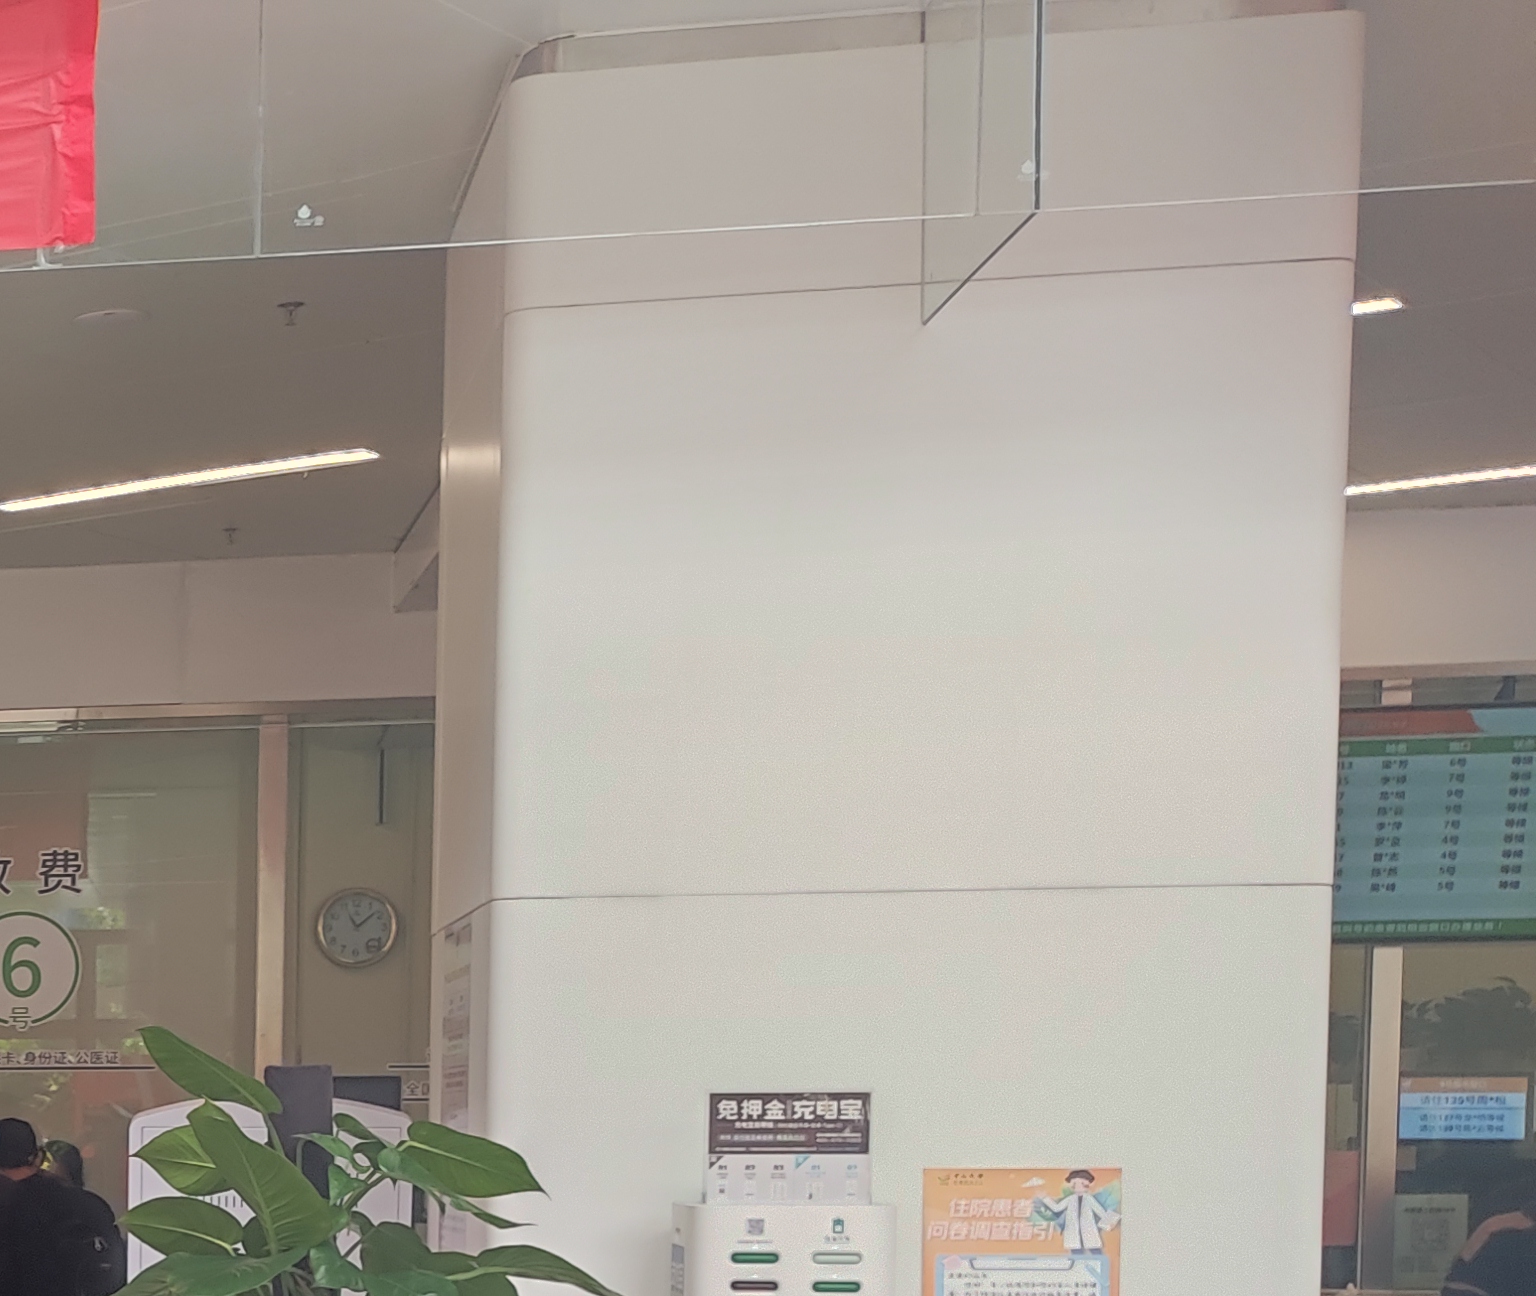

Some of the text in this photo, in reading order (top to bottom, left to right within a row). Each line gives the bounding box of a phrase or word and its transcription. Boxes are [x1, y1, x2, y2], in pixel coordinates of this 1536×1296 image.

[2, 936, 42, 998] 6
[10, 1005, 33, 1031] 号
[716, 1098, 863, 1120] 免押金 充电宝
[949, 1198, 1034, 1218] 住院患者
[928, 1221, 1055, 1241] 问卷调查指引
